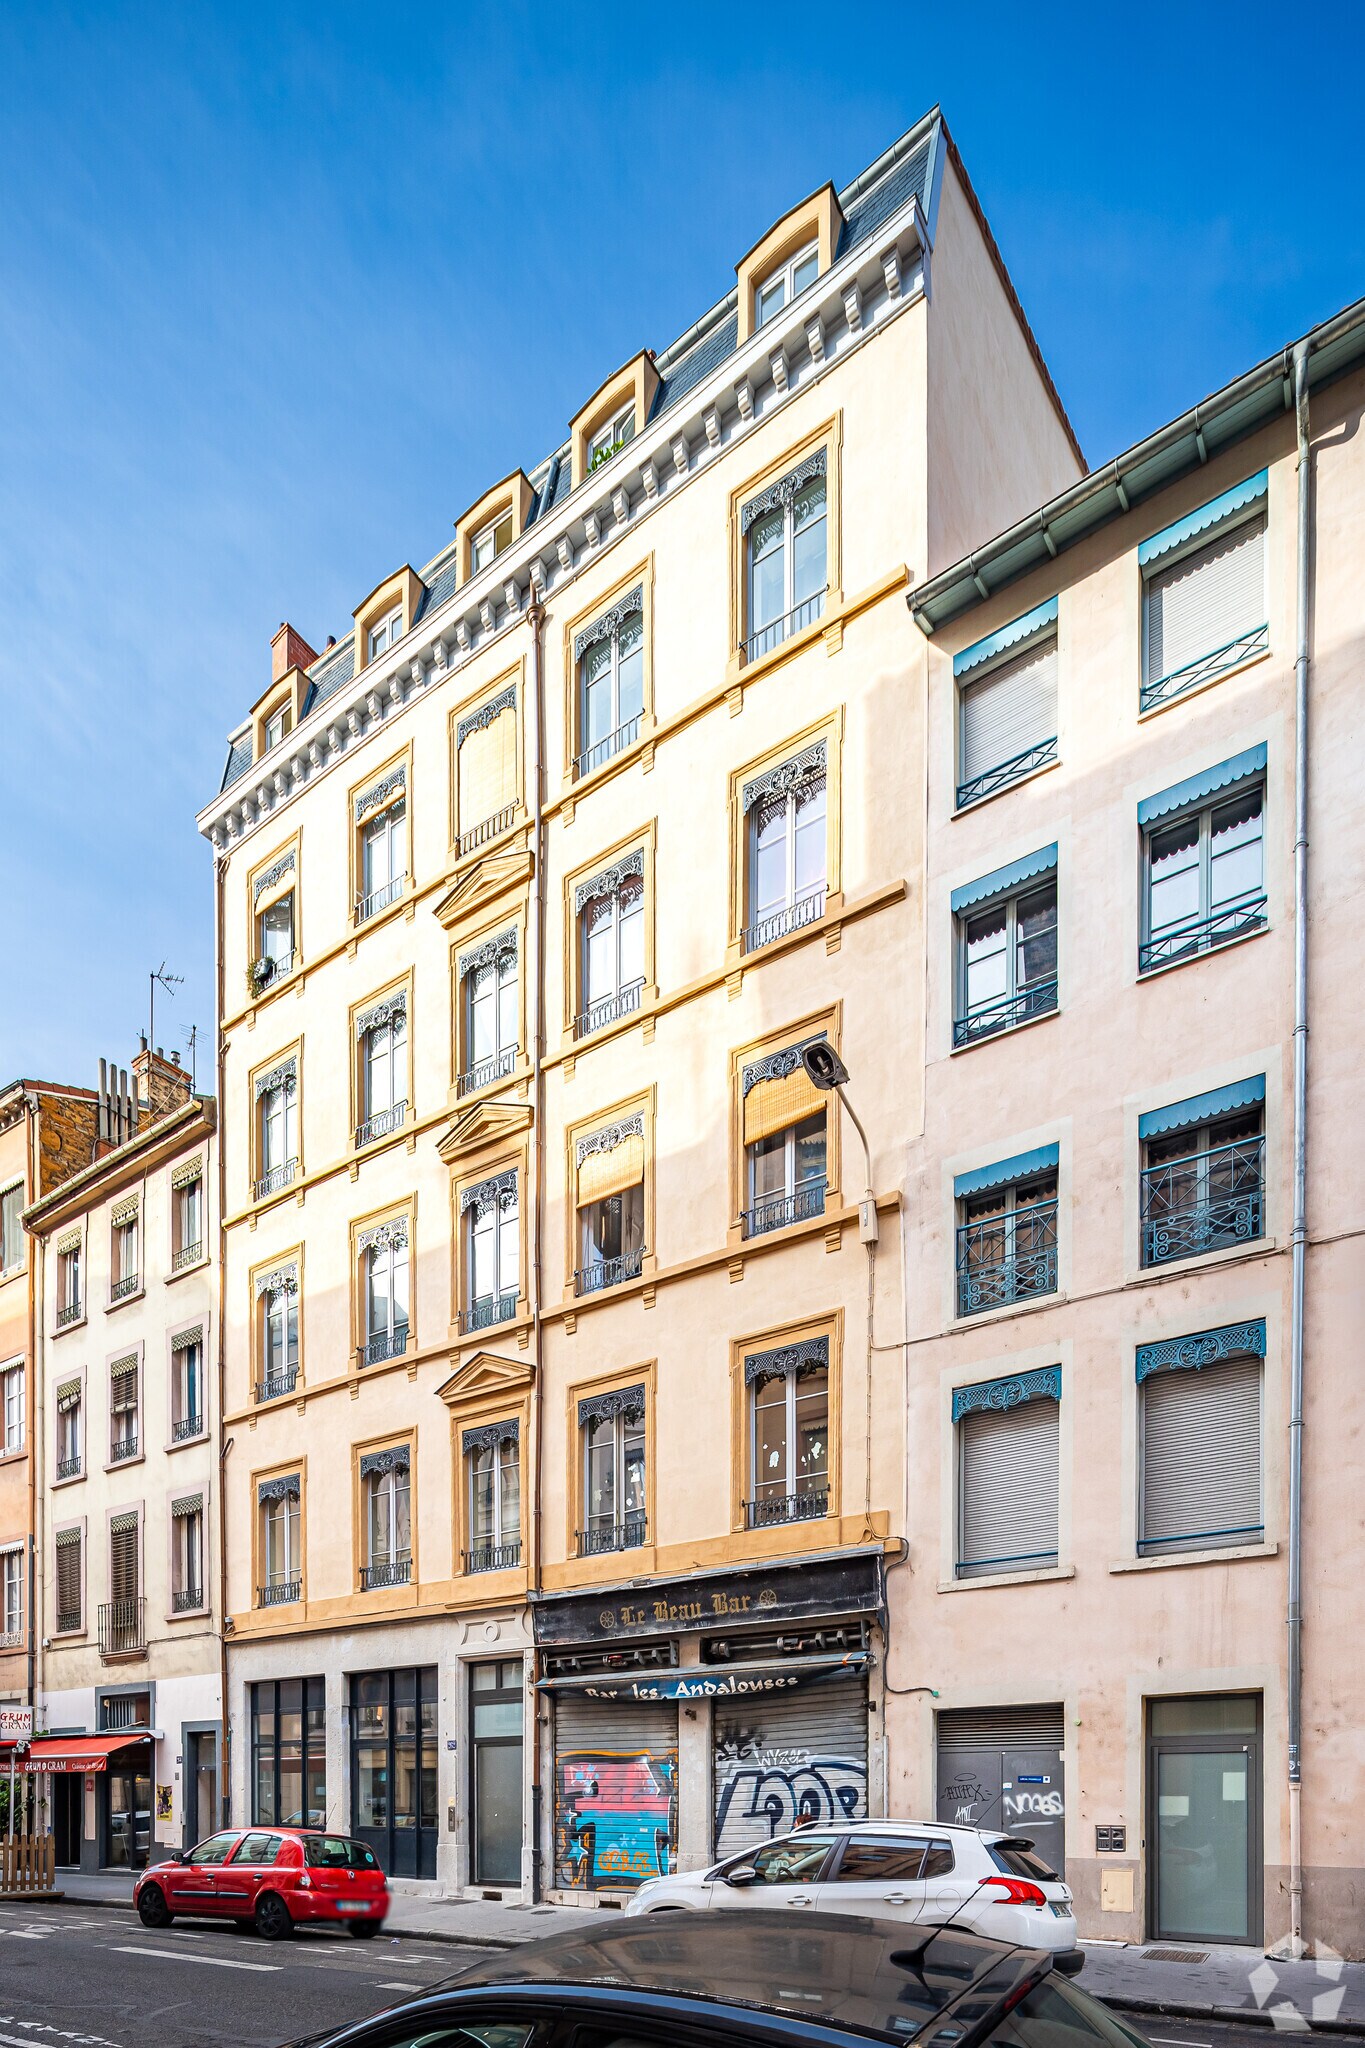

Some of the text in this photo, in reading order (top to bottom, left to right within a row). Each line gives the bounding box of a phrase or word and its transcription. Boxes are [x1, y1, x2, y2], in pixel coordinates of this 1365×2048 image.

[620, 1593, 751, 1627] Le Beau Bar
[632, 1683, 658, 1699] les
[675, 1675, 799, 1697] Andalouses
[0, 1712, 31, 1722] GRUM
[0, 1722, 31, 1730] GRAM
[25, 1762, 41, 1771] GRUM
[47, 1761, 67, 1770] GRAM
